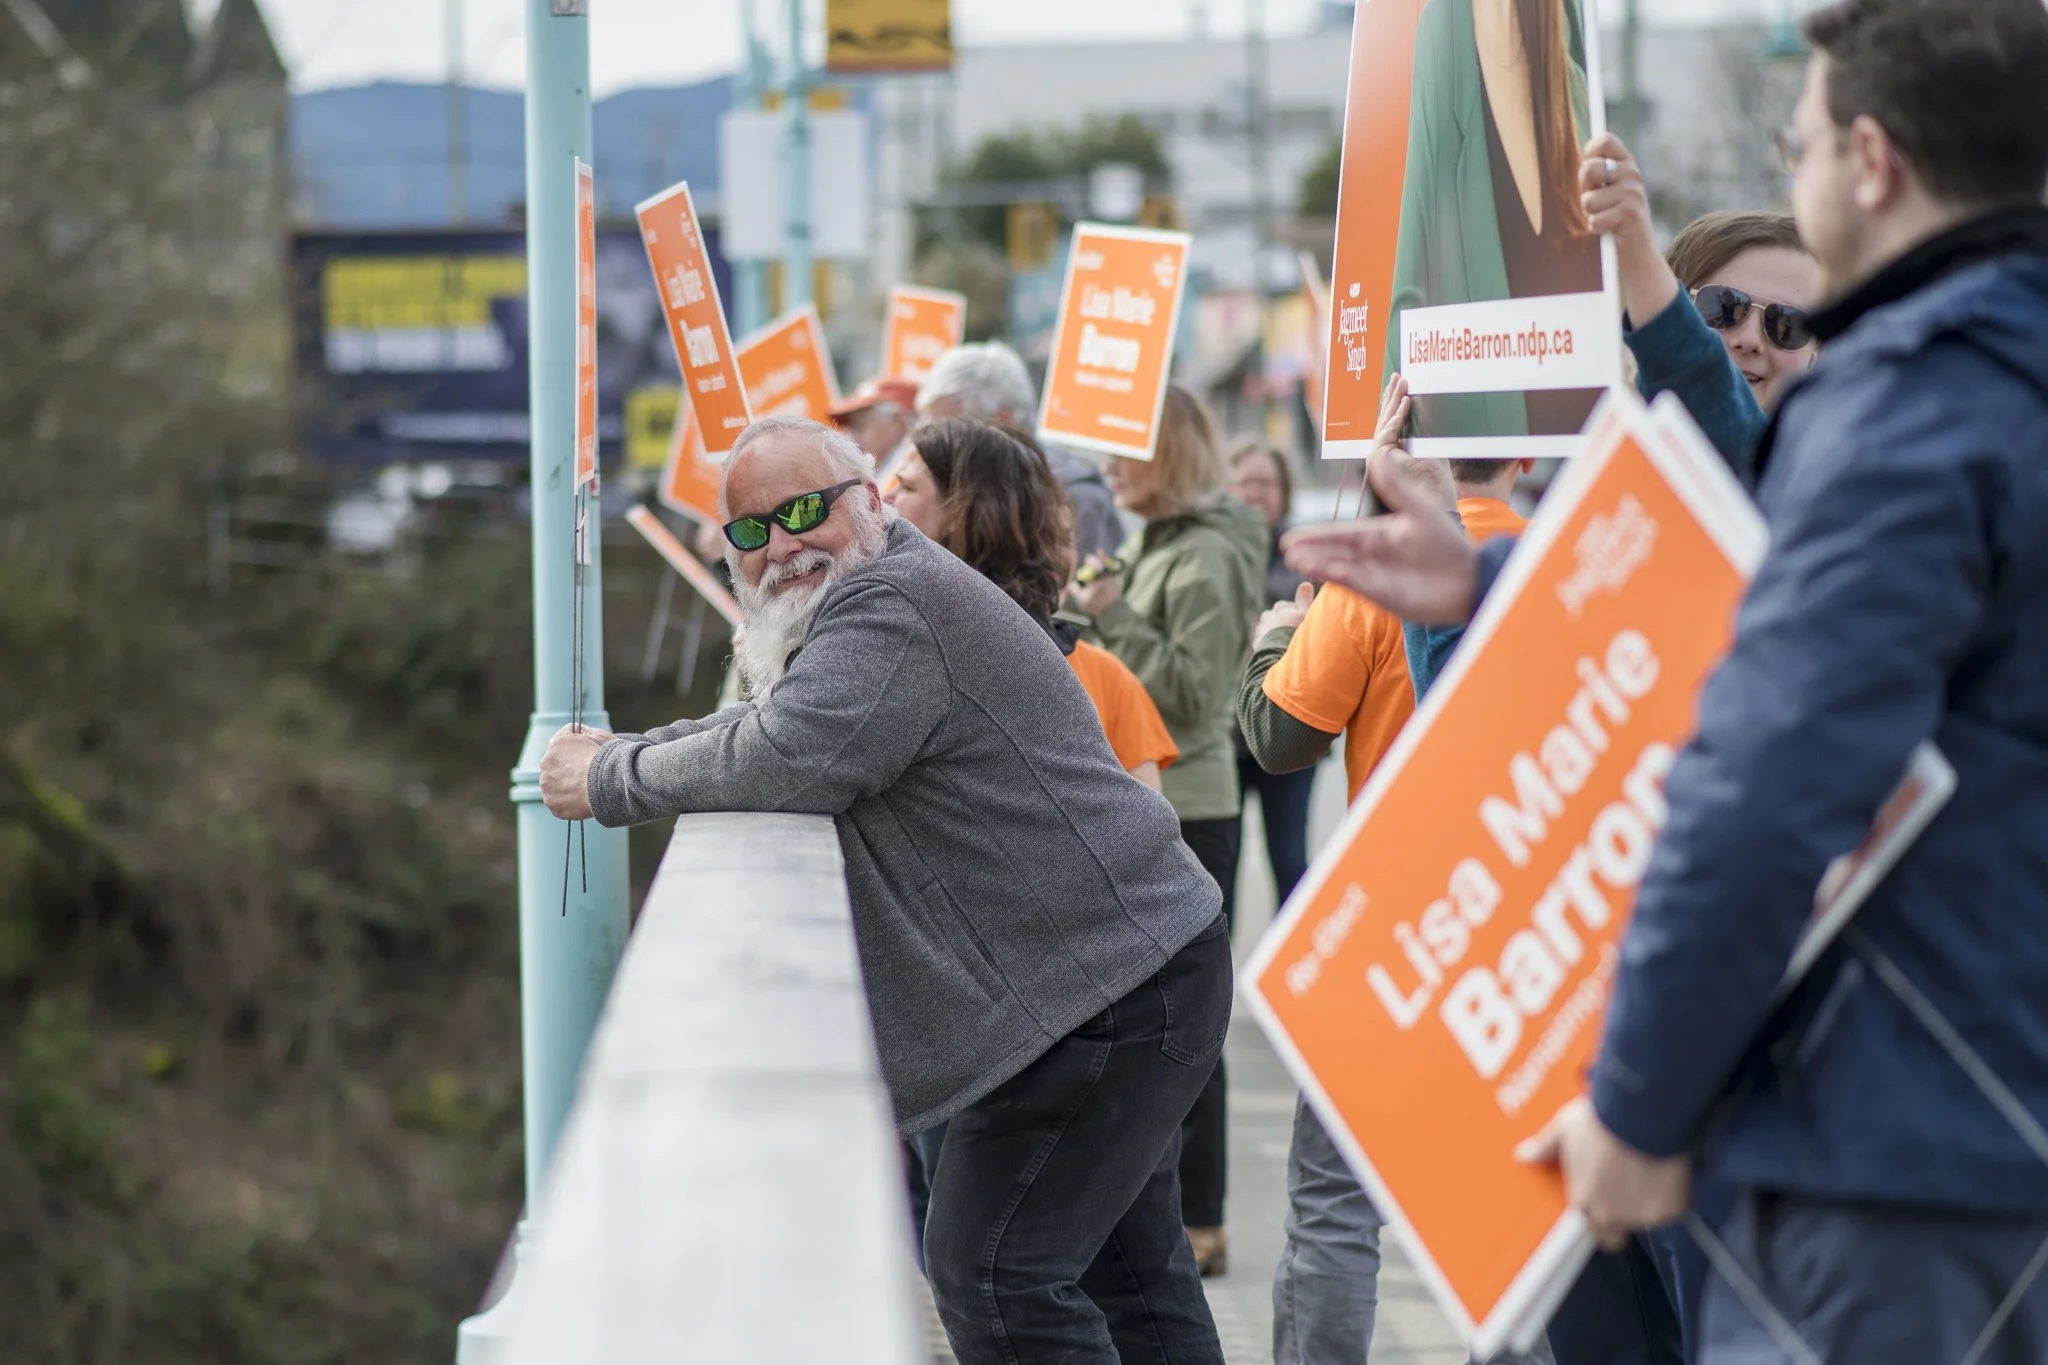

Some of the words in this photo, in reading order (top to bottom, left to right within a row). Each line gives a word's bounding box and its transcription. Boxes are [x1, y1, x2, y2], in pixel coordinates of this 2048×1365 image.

[1337, 299, 1369, 345] Jagmeet
[1409, 321, 1574, 366] LisaMarieBarron.ndp.ca
[1346, 337, 1367, 381] Singh
[1366, 858, 1503, 1030] Lisa
[1478, 629, 1661, 868] Marie
